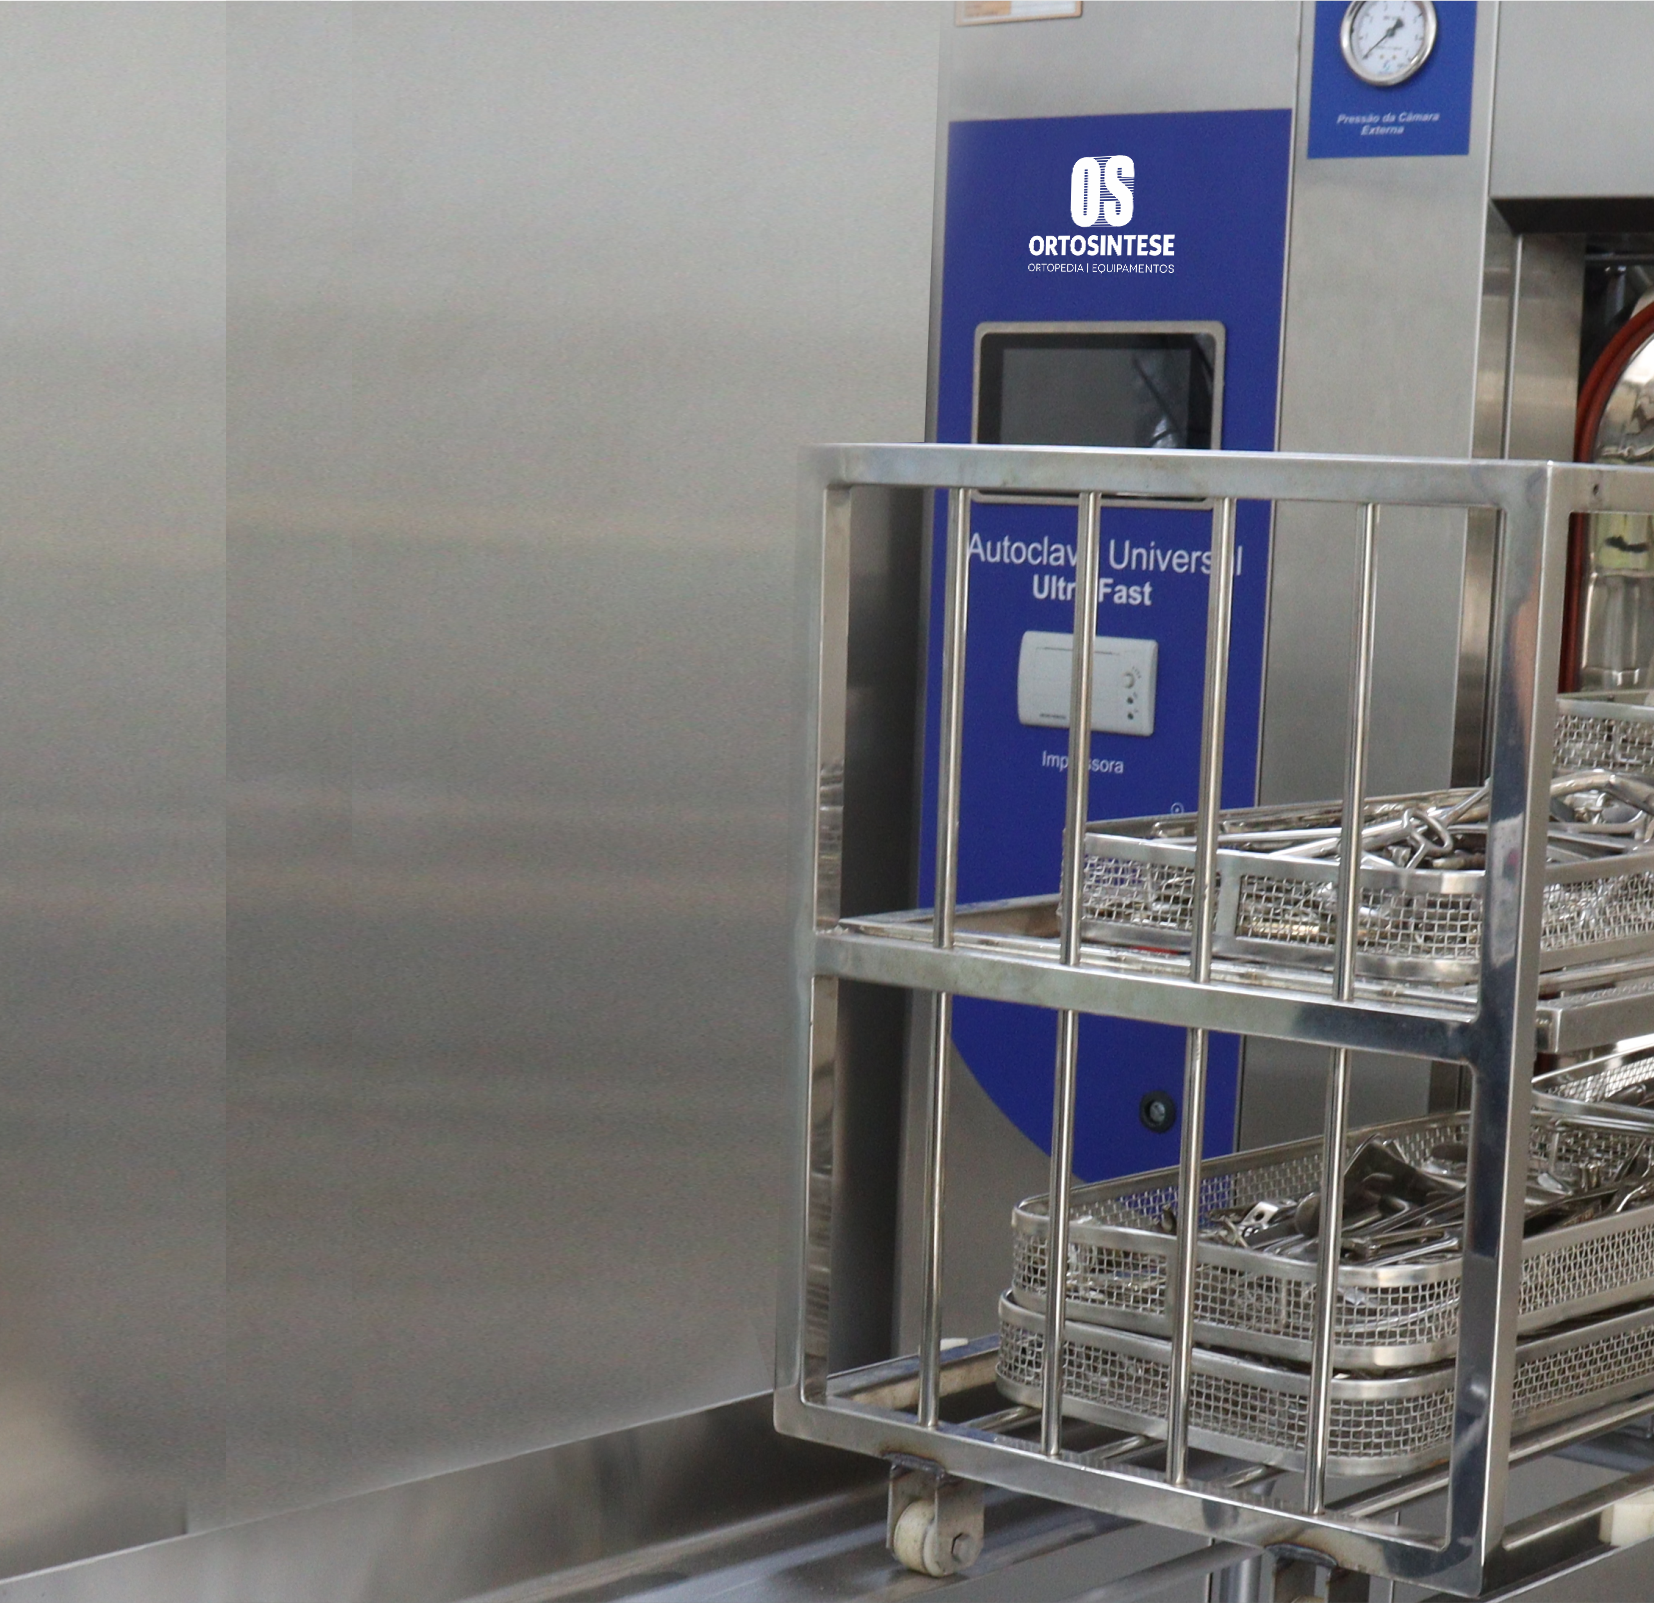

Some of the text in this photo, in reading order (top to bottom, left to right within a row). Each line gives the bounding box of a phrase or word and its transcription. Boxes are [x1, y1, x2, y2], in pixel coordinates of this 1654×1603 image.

[1382, 111, 1396, 123] da
[1360, 124, 1405, 136] Externa
[1070, 154, 1135, 228] OS
[1028, 234, 1176, 257] ORTOSINTESE
[1027, 262, 1176, 274] ORTOPEDIA EQUIPAMENTOS
[968, 532, 1244, 577] Autoclav Universl
[1032, 573, 1153, 606] Ultr Fast
